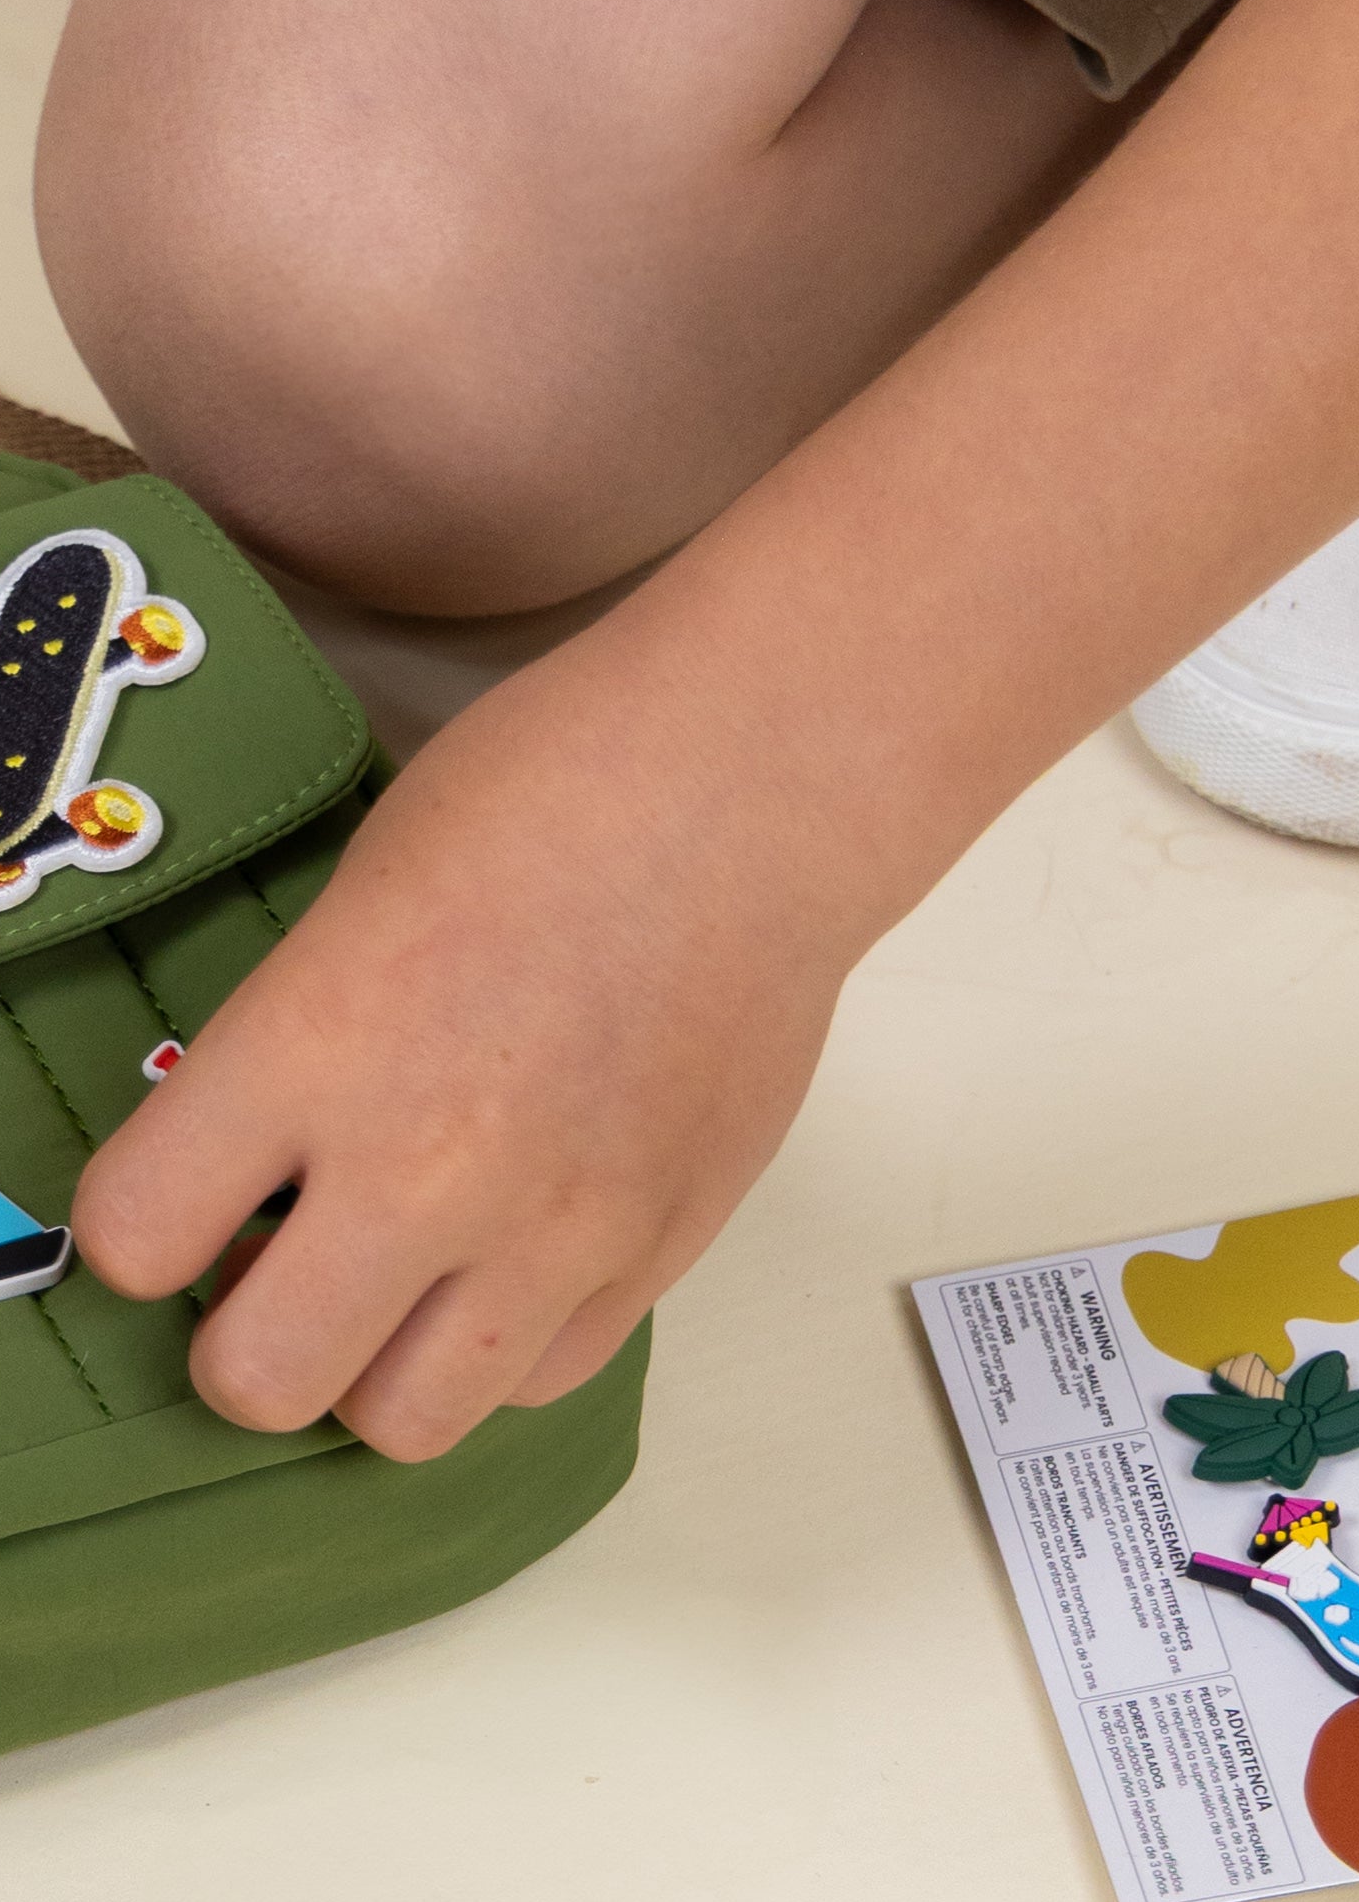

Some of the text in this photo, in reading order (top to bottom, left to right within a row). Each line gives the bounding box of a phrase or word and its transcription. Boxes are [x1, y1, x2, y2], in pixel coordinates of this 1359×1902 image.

[984, 1281, 1016, 1345] SHARP EDGES
[1079, 1290, 1117, 1361] WARNING
[1050, 1269, 1075, 1315] CHOKING
[1066, 1314, 1089, 1355] HAZARD
[1082, 1363, 1102, 1395] SMALL
[1093, 1395, 1114, 1428] PARTS
[1063, 1450, 1077, 1465] en
[1096, 1444, 1109, 1459] Ne
[1111, 1441, 1136, 1483] DANGER
[1013, 1460, 1026, 1475] Ne
[1027, 1457, 1046, 1488] Faites
[1068, 1464, 1085, 1486] tout
[1100, 1459, 1125, 1503] convient
[1126, 1483, 1141, 1498] DE
[1017, 1475, 1042, 1519] convient
[1042, 1454, 1087, 1560] BORDS TRANCHANTS
[1037, 1487, 1061, 1534] attention
[1112, 1503, 1131, 1524] pas
[1029, 1519, 1047, 1540] pas
[1079, 1447, 1149, 1629] La supervision d'un adulte est requise
[1122, 1524, 1137, 1543] aux
[1131, 1498, 1165, 1570] SUFFOCATION
[1039, 1540, 1053, 1560] aux
[1053, 1534, 1067, 1554] aux
[1059, 1553, 1078, 1584] bords
[1129, 1544, 1151, 1583] enfants
[1046, 1560, 1067, 1599] enfants
[1142, 1582, 1156, 1598] de
[1059, 1599, 1072, 1614] de
[1158, 1577, 1182, 1616] PETITES
[1148, 1598, 1167, 1630] moins
[1064, 1614, 1083, 1647] moins
[1159, 1630, 1172, 1645] de
[1171, 1616, 1194, 1652] PIÈCES
[1075, 1647, 1088, 1661] de
[1163, 1645, 1178, 1654] 3
[1080, 1661, 1093, 1670] 3
[1148, 1695, 1161, 1710] en
[1164, 1692, 1178, 1706] Se
[1181, 1688, 1194, 1704] No
[1197, 1685, 1221, 1727] PELIGRO
[1095, 1704, 1109, 1720] No
[1110, 1702, 1130, 1735] Tenga
[1153, 1709, 1170, 1735] todo
[1184, 1704, 1203, 1729] apto
[1099, 1720, 1117, 1745] apto
[1170, 1706, 1193, 1749] requiere
[1211, 1727, 1227, 1741] DE
[1125, 1699, 1166, 1790] BORDES AFILADOS
[1185, 1749, 1197, 1761] la
[1191, 1729, 1212, 1755] para
[1105, 1745, 1126, 1771] para
[1121, 1735, 1145, 1778] cuidado
[1203, 1755, 1222, 1784] niños
[1216, 1743, 1240, 1781] ASFIXIA
[1223, 1708, 1273, 1812] ADVERTENCIA
[1118, 1771, 1136, 1799] niños
[1136, 1777, 1152, 1798] con
[1143, 1797, 1157, 1814] los
[1214, 1784, 1238, 1830] menores
[1127, 1799, 1152, 1845] menores
[1149, 1813, 1170, 1851] bordes
[1209, 1820, 1223, 1835] de
[1214, 1835, 1228, 1851] un
[1230, 1830, 1244, 1845] de
[1235, 1845, 1249, 1854] 3
[1244, 1821, 1273, 1875] PEQUEÑAS
[1144, 1845, 1157, 1860] de
[1149, 1859, 1162, 1868] 3
[1220, 1851, 1240, 1886] adulto
